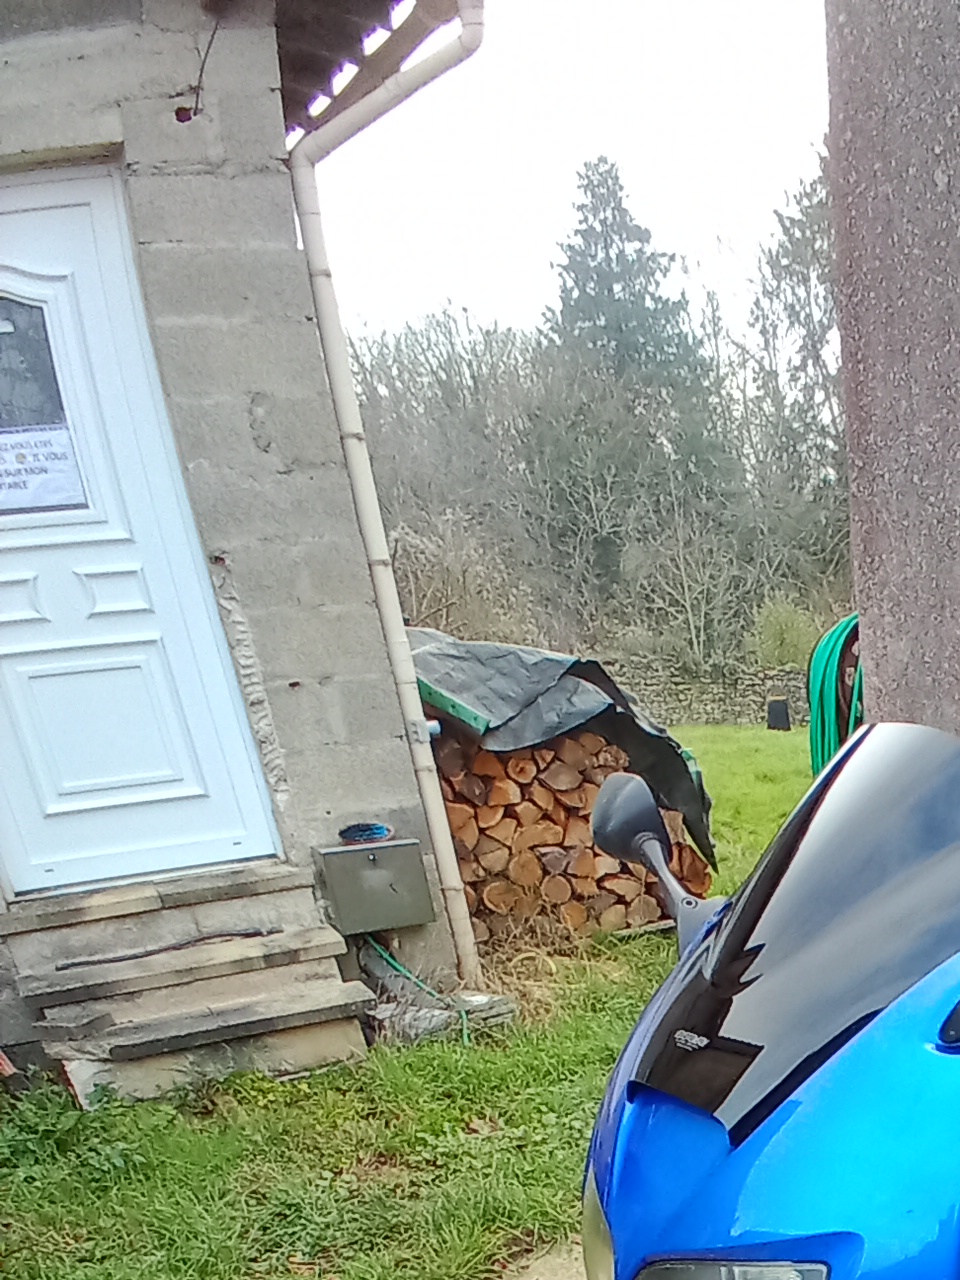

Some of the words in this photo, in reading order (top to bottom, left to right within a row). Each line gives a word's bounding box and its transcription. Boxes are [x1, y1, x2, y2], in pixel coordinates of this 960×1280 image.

[43, 451, 69, 461] VOUS
[4, 467, 23, 477] SUR
[24, 466, 48, 476] MON
